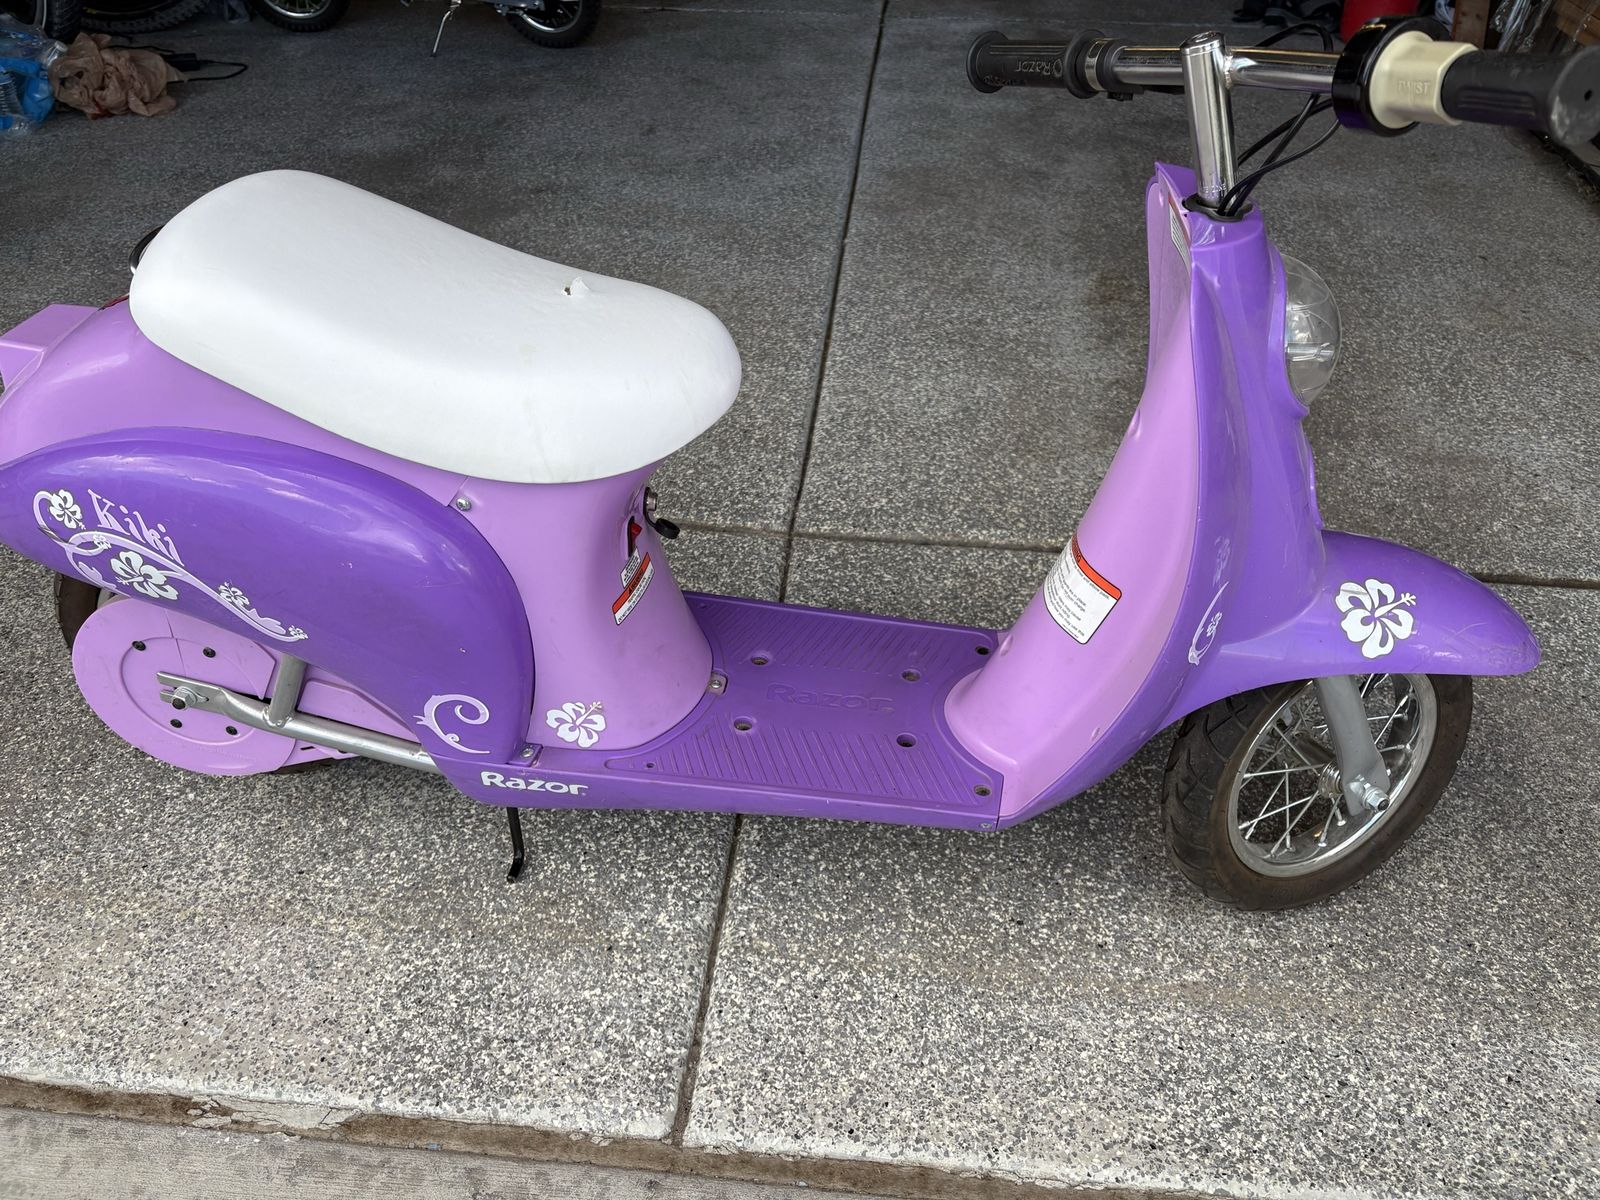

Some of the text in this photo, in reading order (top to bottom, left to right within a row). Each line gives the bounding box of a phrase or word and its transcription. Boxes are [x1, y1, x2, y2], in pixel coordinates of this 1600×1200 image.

[1015, 61, 1051, 76] Razor
[87, 489, 185, 567] Kiki
[767, 683, 893, 711] Razor
[481, 771, 589, 795] Razor
